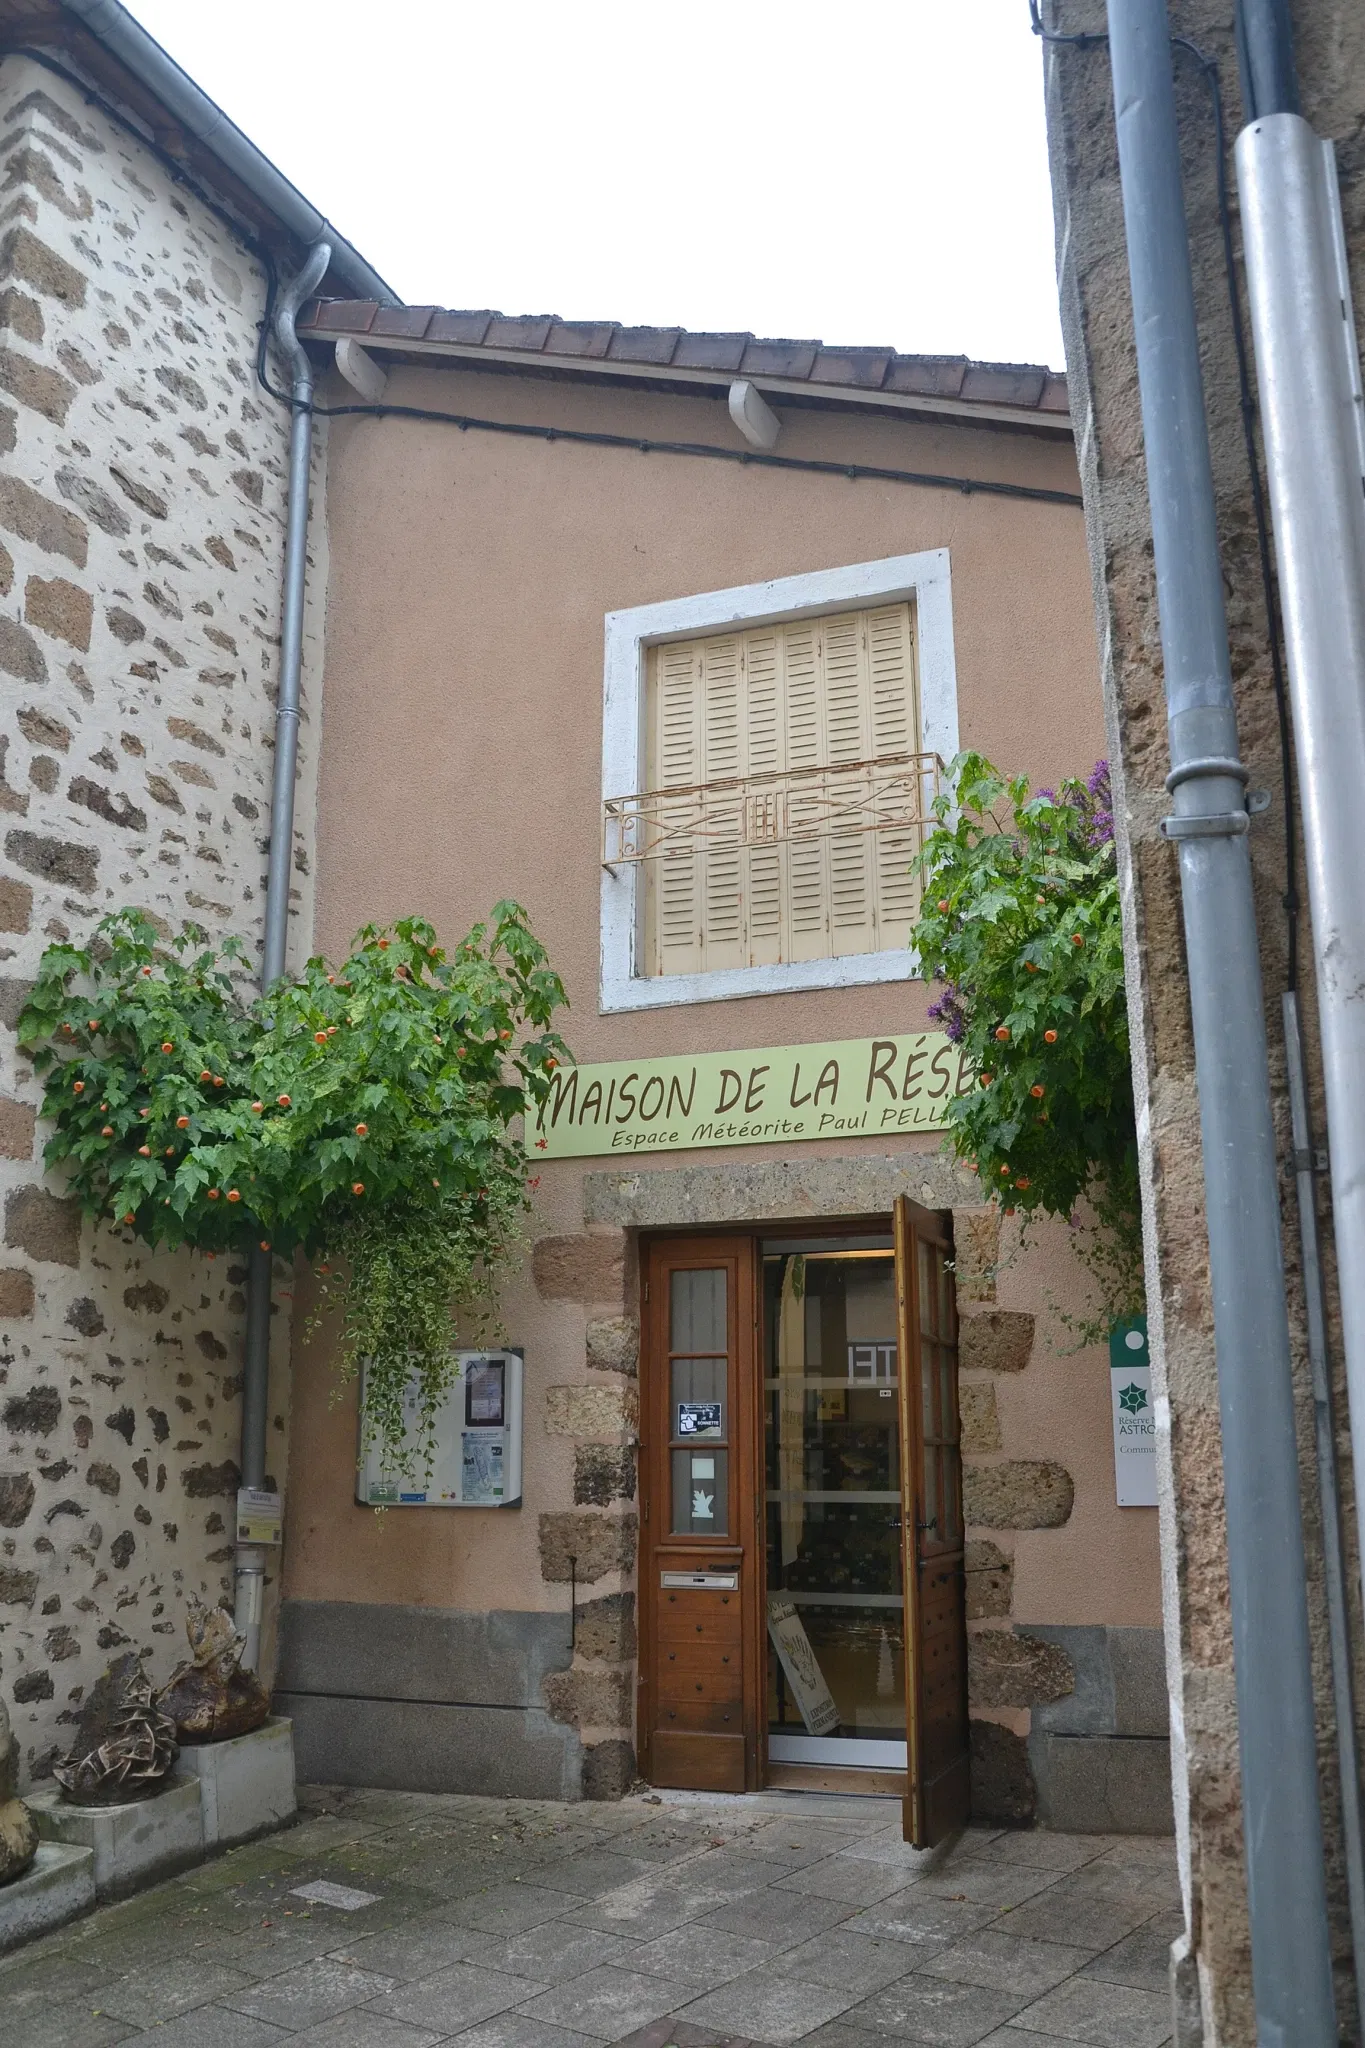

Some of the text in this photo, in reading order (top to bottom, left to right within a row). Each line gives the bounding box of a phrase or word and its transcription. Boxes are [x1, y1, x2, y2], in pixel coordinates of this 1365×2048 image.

[536, 1067, 696, 1131] MAISON
[714, 1064, 771, 1116] DE
[789, 1058, 840, 1109] LA
[611, 1130, 679, 1150] Espace
[691, 1118, 806, 1141] Météorite
[818, 1110, 868, 1132] Paul
